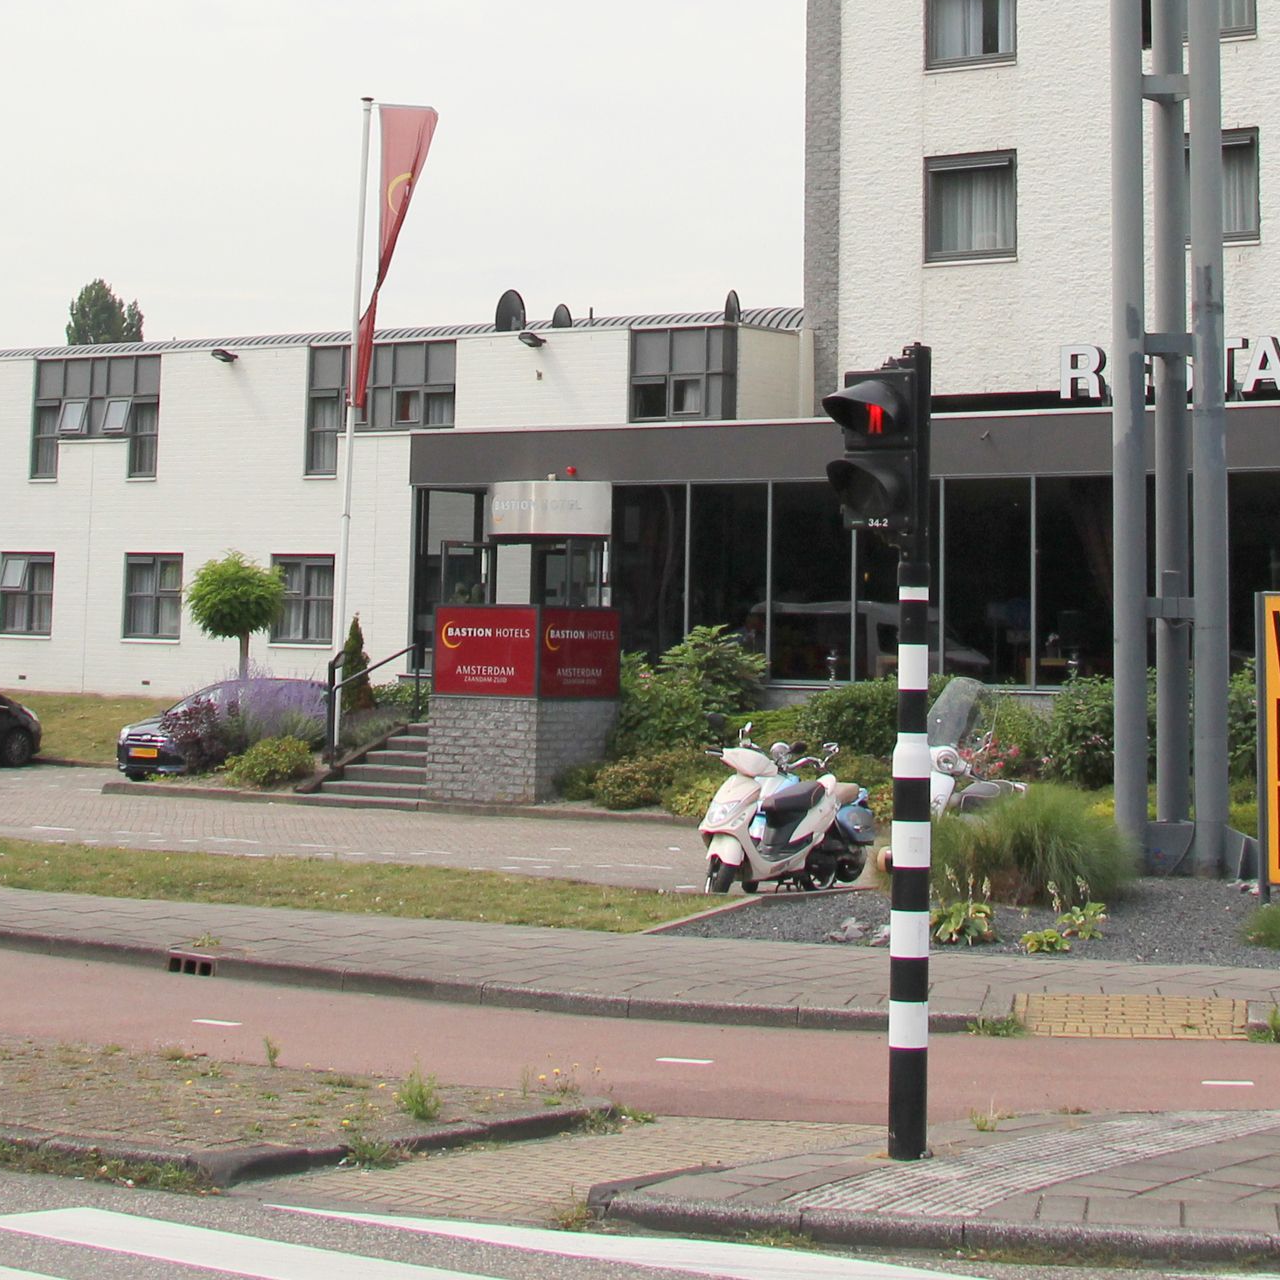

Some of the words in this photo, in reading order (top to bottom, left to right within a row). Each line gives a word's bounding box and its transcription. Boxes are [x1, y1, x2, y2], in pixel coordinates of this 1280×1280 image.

[447, 627, 492, 637] BASTION
[495, 628, 530, 638] HOTELS
[550, 630, 585, 639] BASTION
[587, 630, 615, 640] HOTELS
[455, 665, 515, 676] AMSTERDAM
[557, 667, 602, 678] AMSTERDAM
